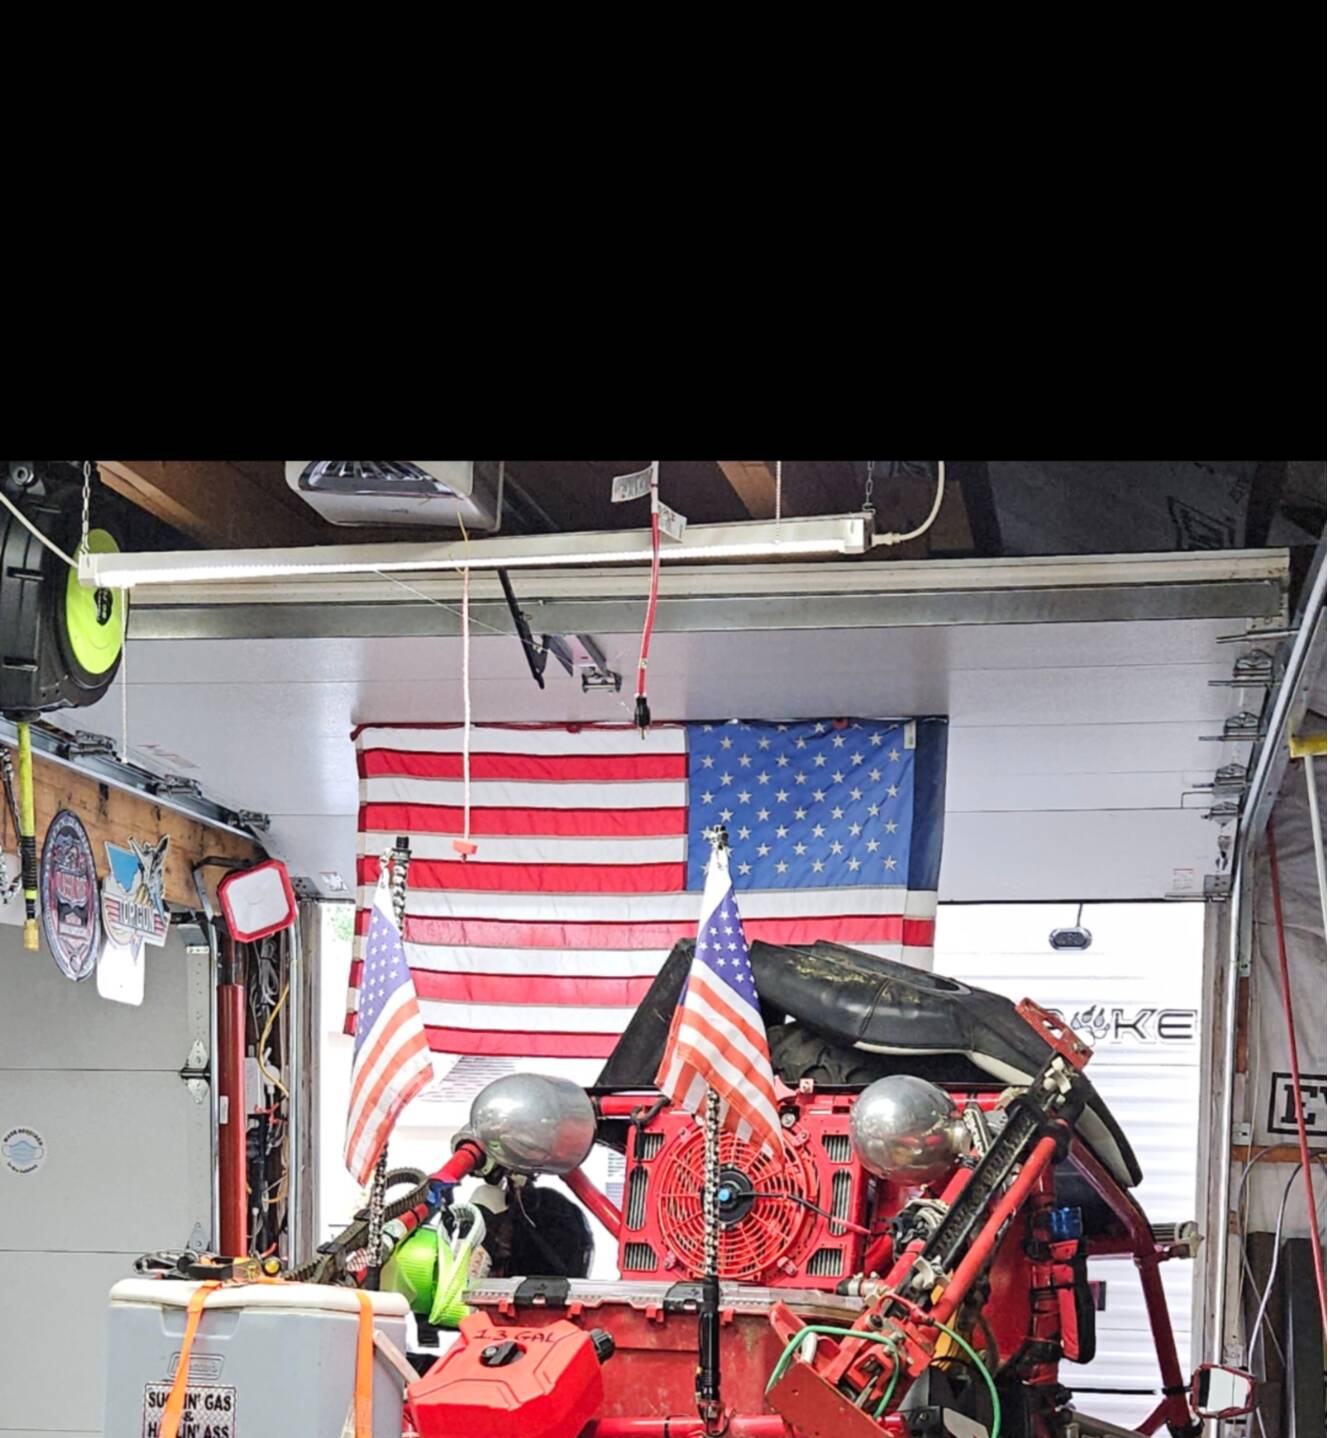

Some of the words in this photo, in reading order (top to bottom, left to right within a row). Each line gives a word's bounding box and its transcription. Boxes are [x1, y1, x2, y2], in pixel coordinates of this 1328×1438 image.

[514, 1330, 556, 1343] GAL
[148, 1391, 201, 1410] SUIN'
[204, 1393, 232, 1412] GAS
[183, 1411, 194, 1422] &
